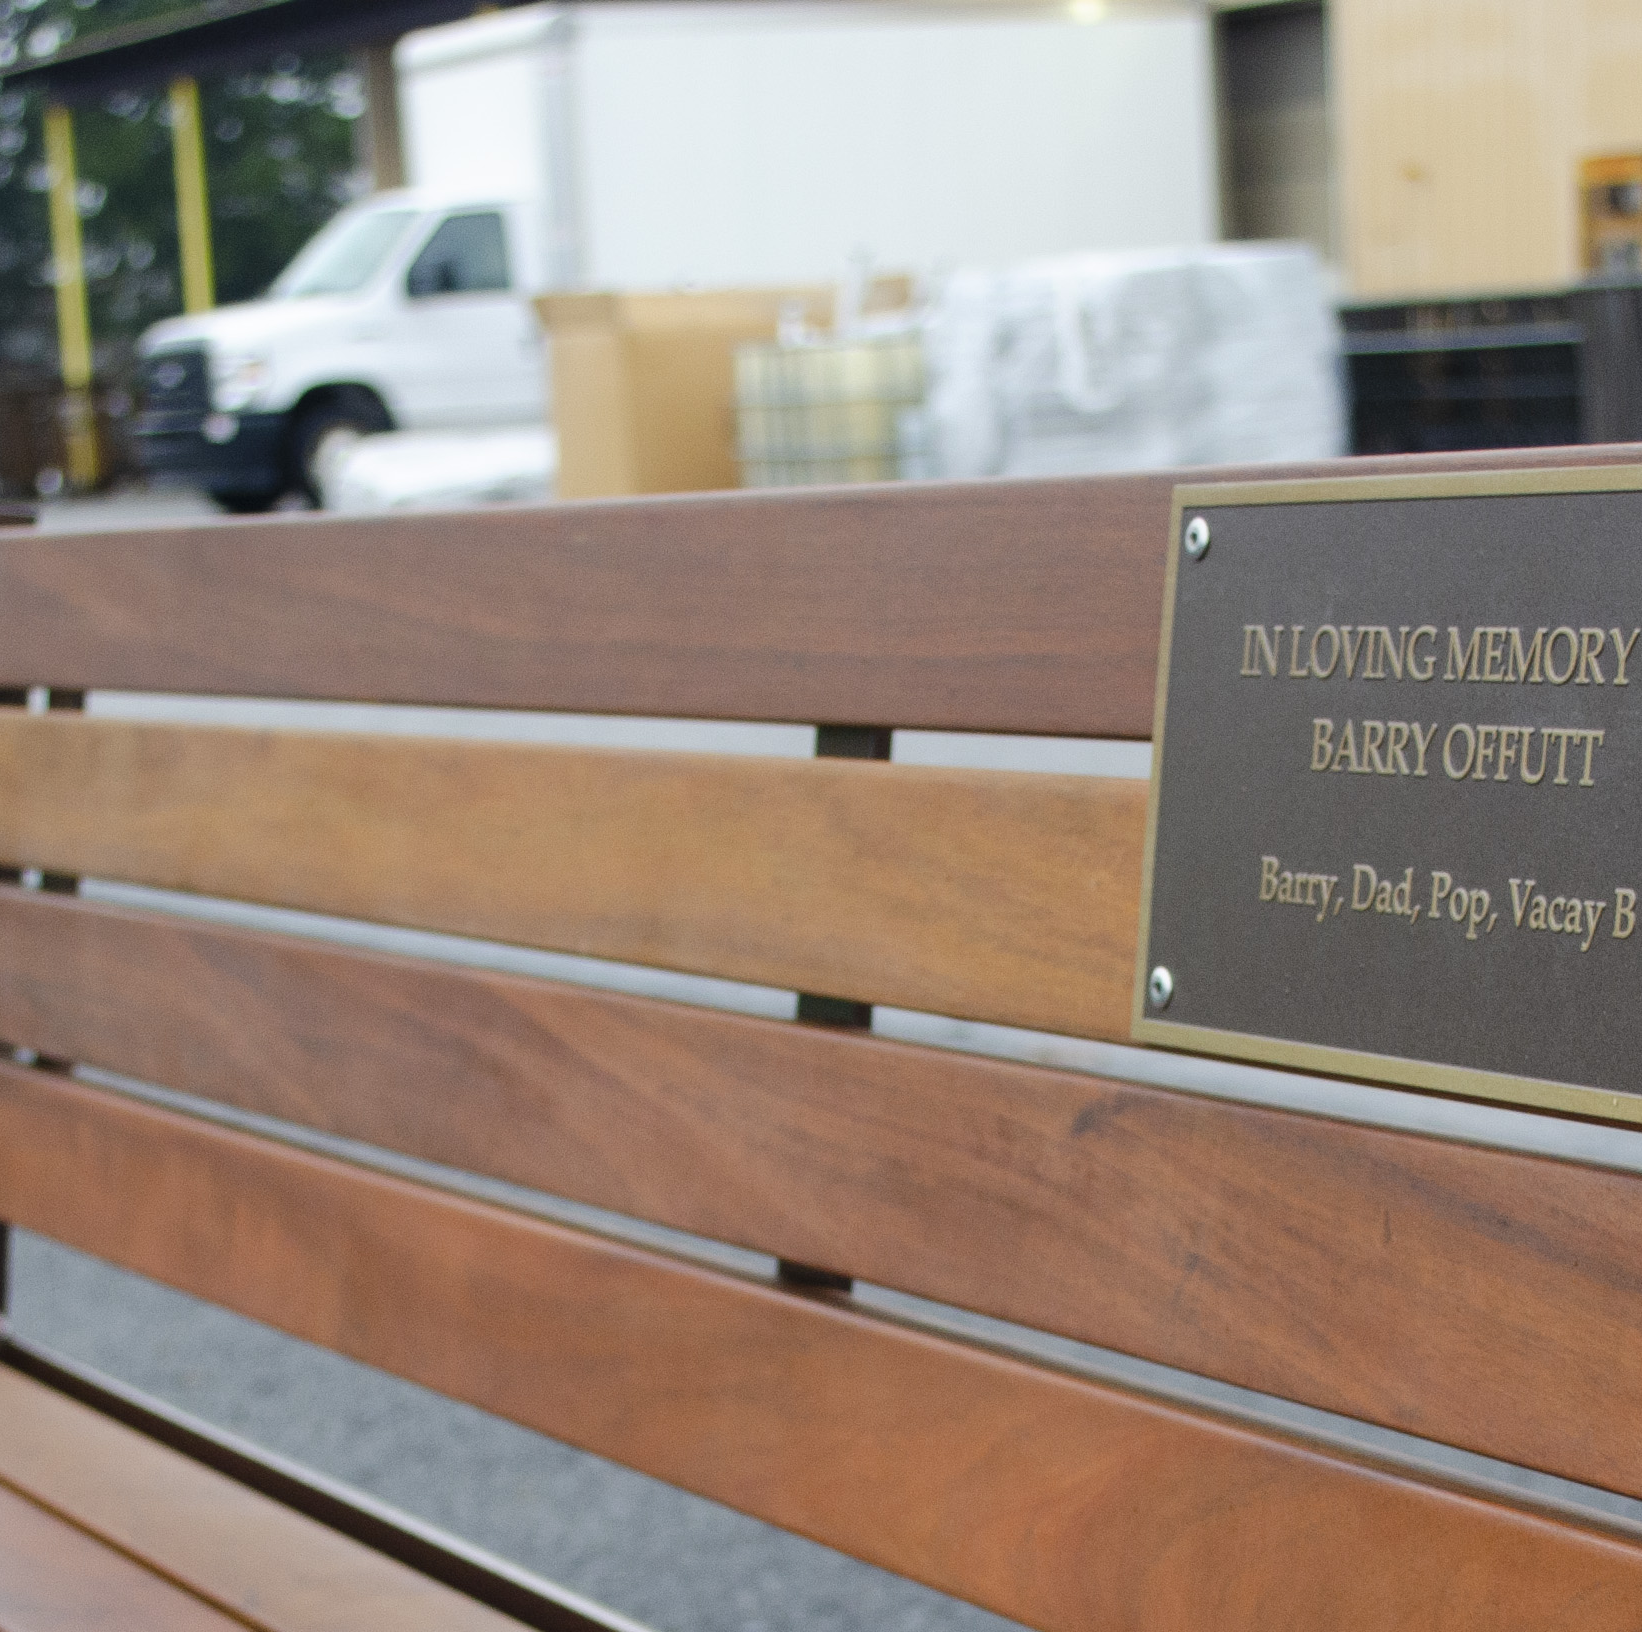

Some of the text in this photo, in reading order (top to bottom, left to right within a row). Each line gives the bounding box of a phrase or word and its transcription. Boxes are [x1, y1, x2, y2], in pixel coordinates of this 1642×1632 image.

[1240, 624, 1284, 677] IN
[1288, 624, 1438, 682] LOVING
[1443, 625, 1641, 686] MEMORY
[1310, 717, 1605, 787] BARRY OFFUTT
[1259, 855, 1637, 953] Barry, Dad, Pop, Vacay B
